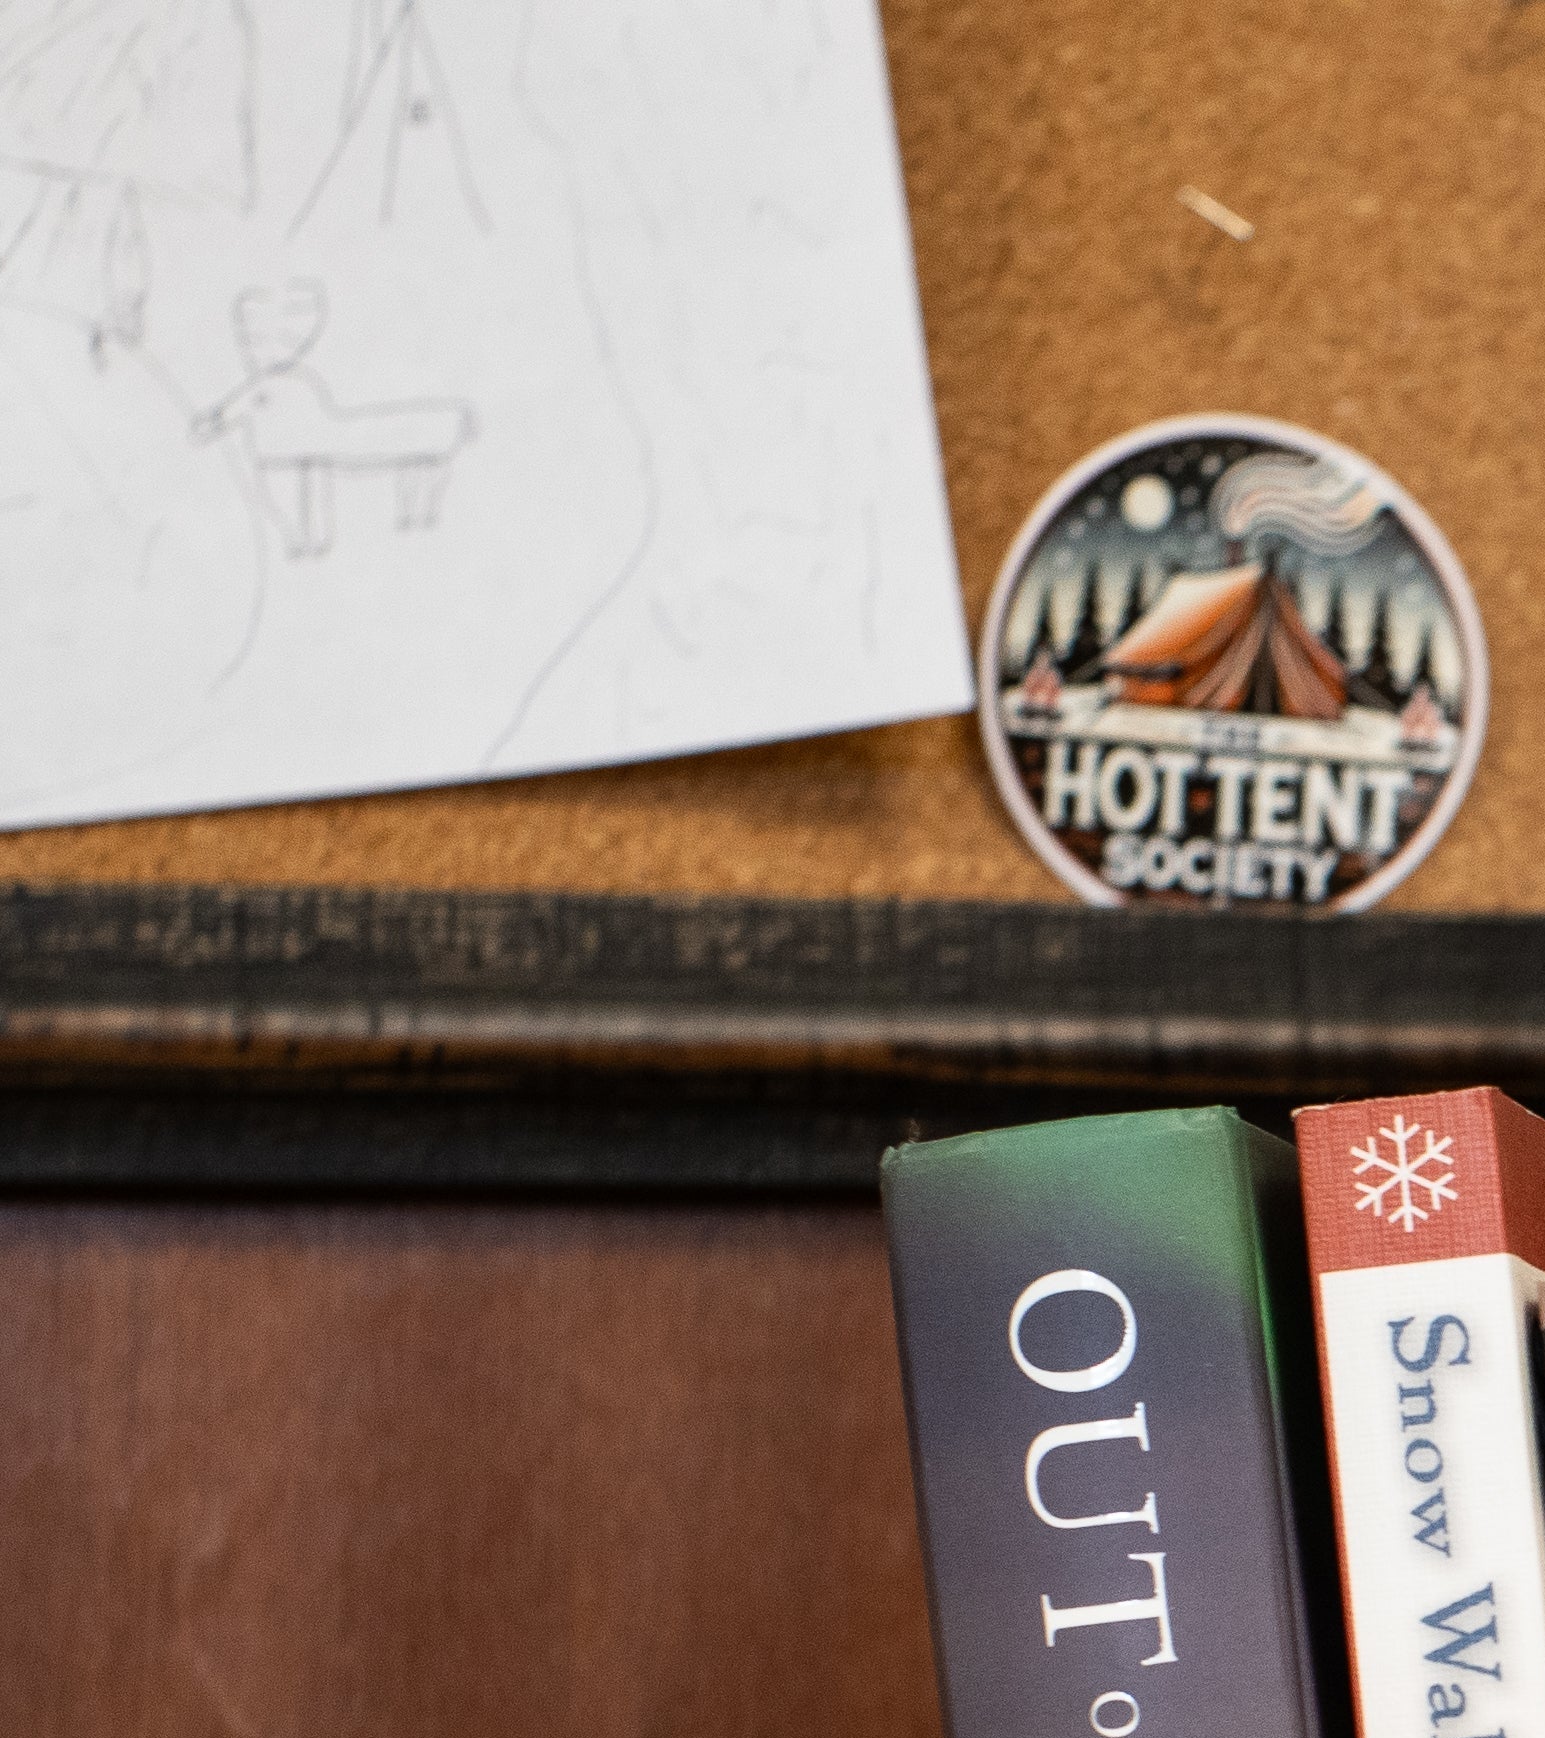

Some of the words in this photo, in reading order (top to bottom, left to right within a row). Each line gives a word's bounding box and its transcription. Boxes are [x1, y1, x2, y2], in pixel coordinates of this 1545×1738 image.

[1043, 740, 1194, 836] HOT
[1202, 751, 1416, 852] TENT
[1100, 832, 1340, 900] SOCIETY
[1008, 1269, 1178, 1667] OUT
[1387, 1313, 1472, 1558] Snow
